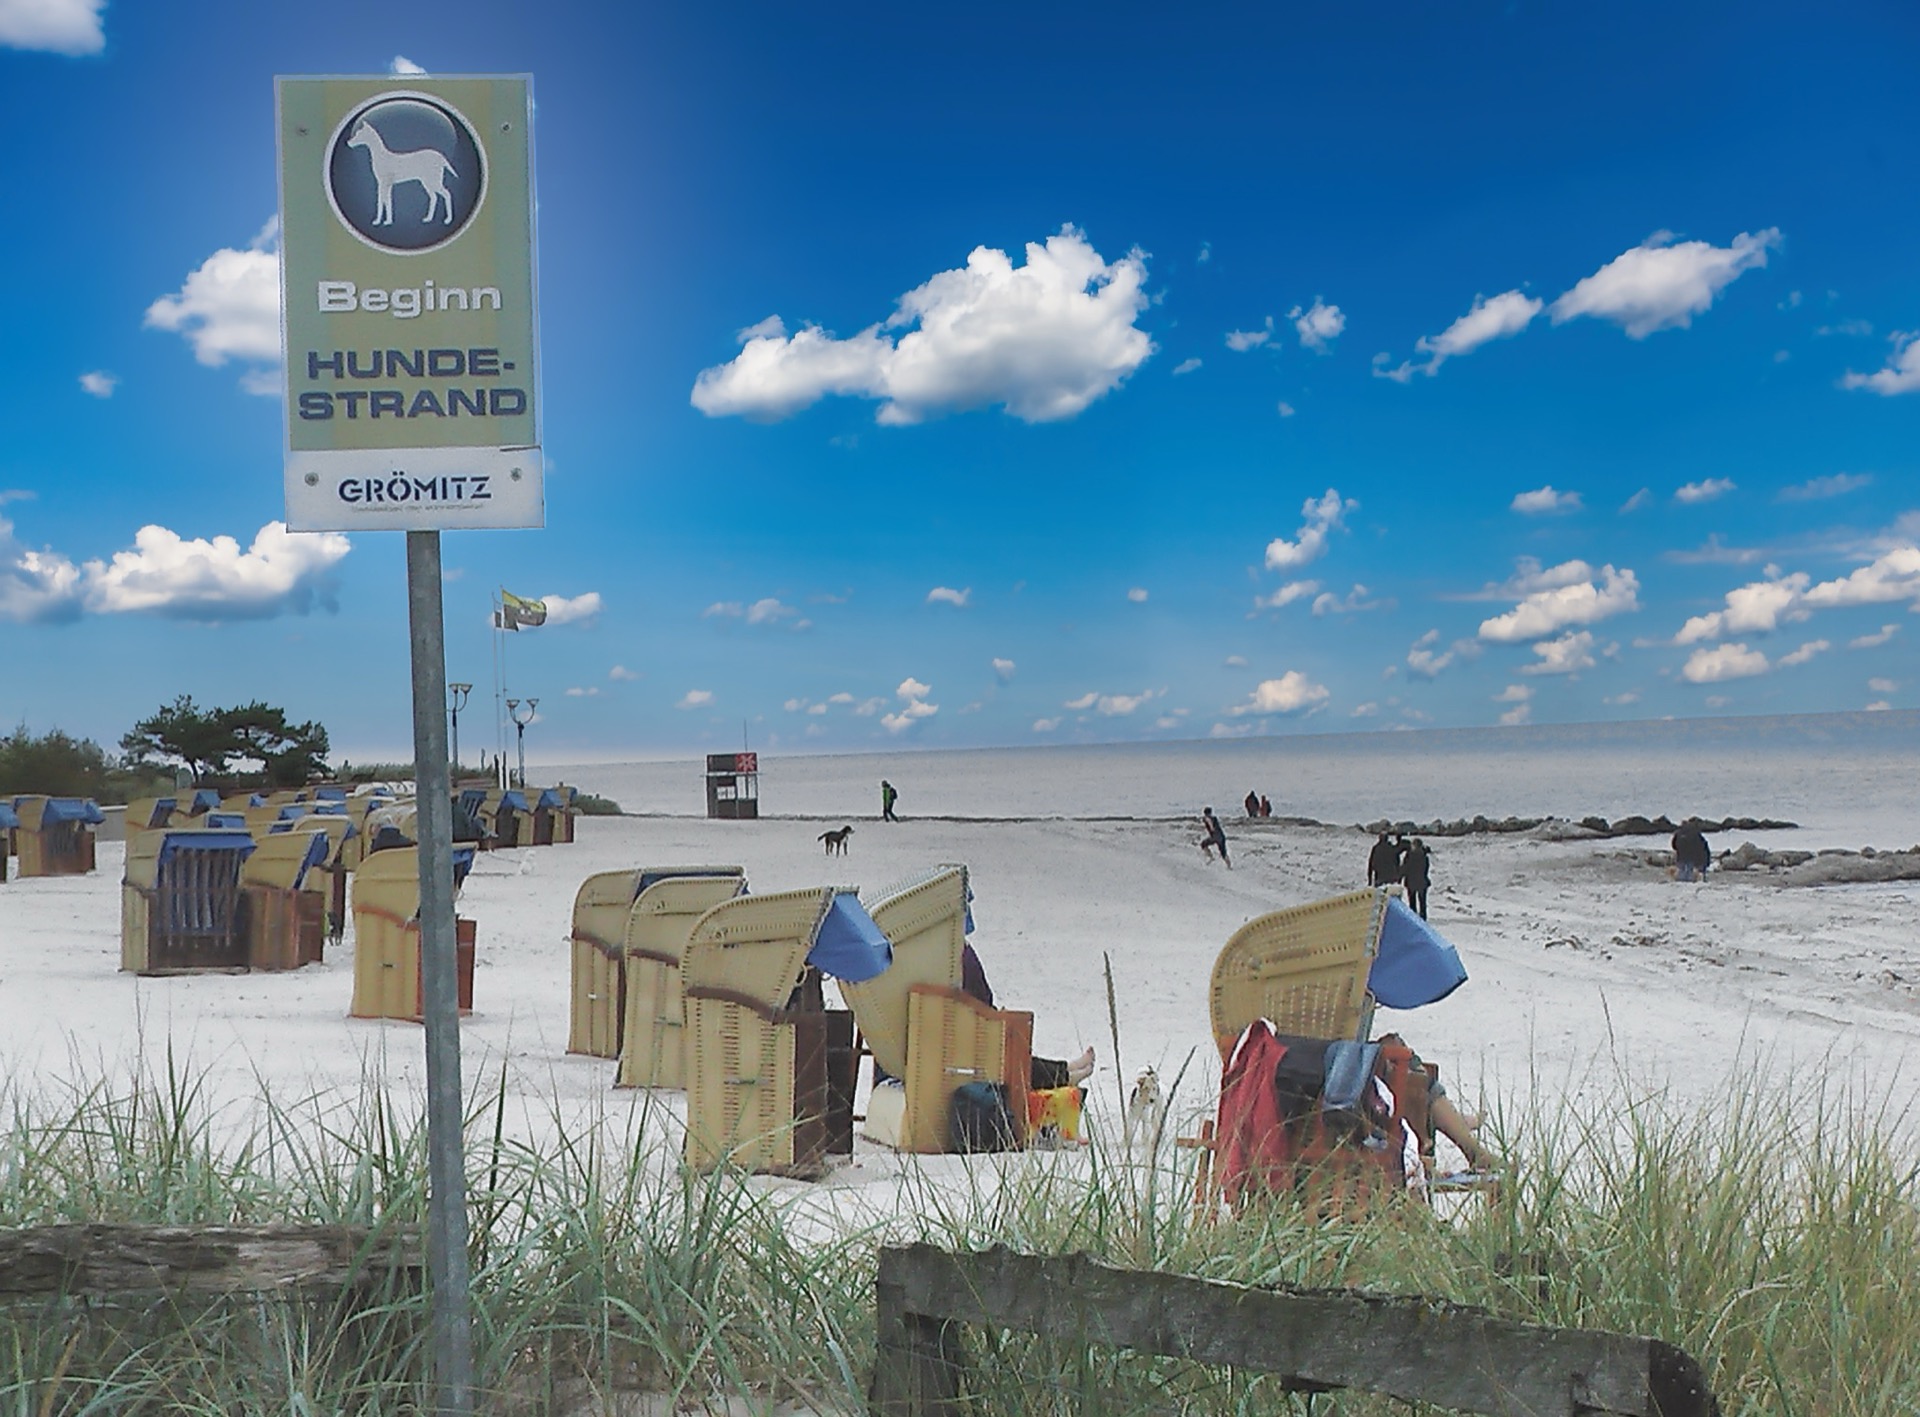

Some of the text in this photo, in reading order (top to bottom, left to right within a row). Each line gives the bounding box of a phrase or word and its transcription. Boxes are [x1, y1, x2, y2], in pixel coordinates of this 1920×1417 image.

[318, 280, 502, 318] Beginn
[307, 348, 516, 379] HUNDE-
[299, 388, 527, 420] STRAND
[338, 471, 492, 502] GRÖMITZ
